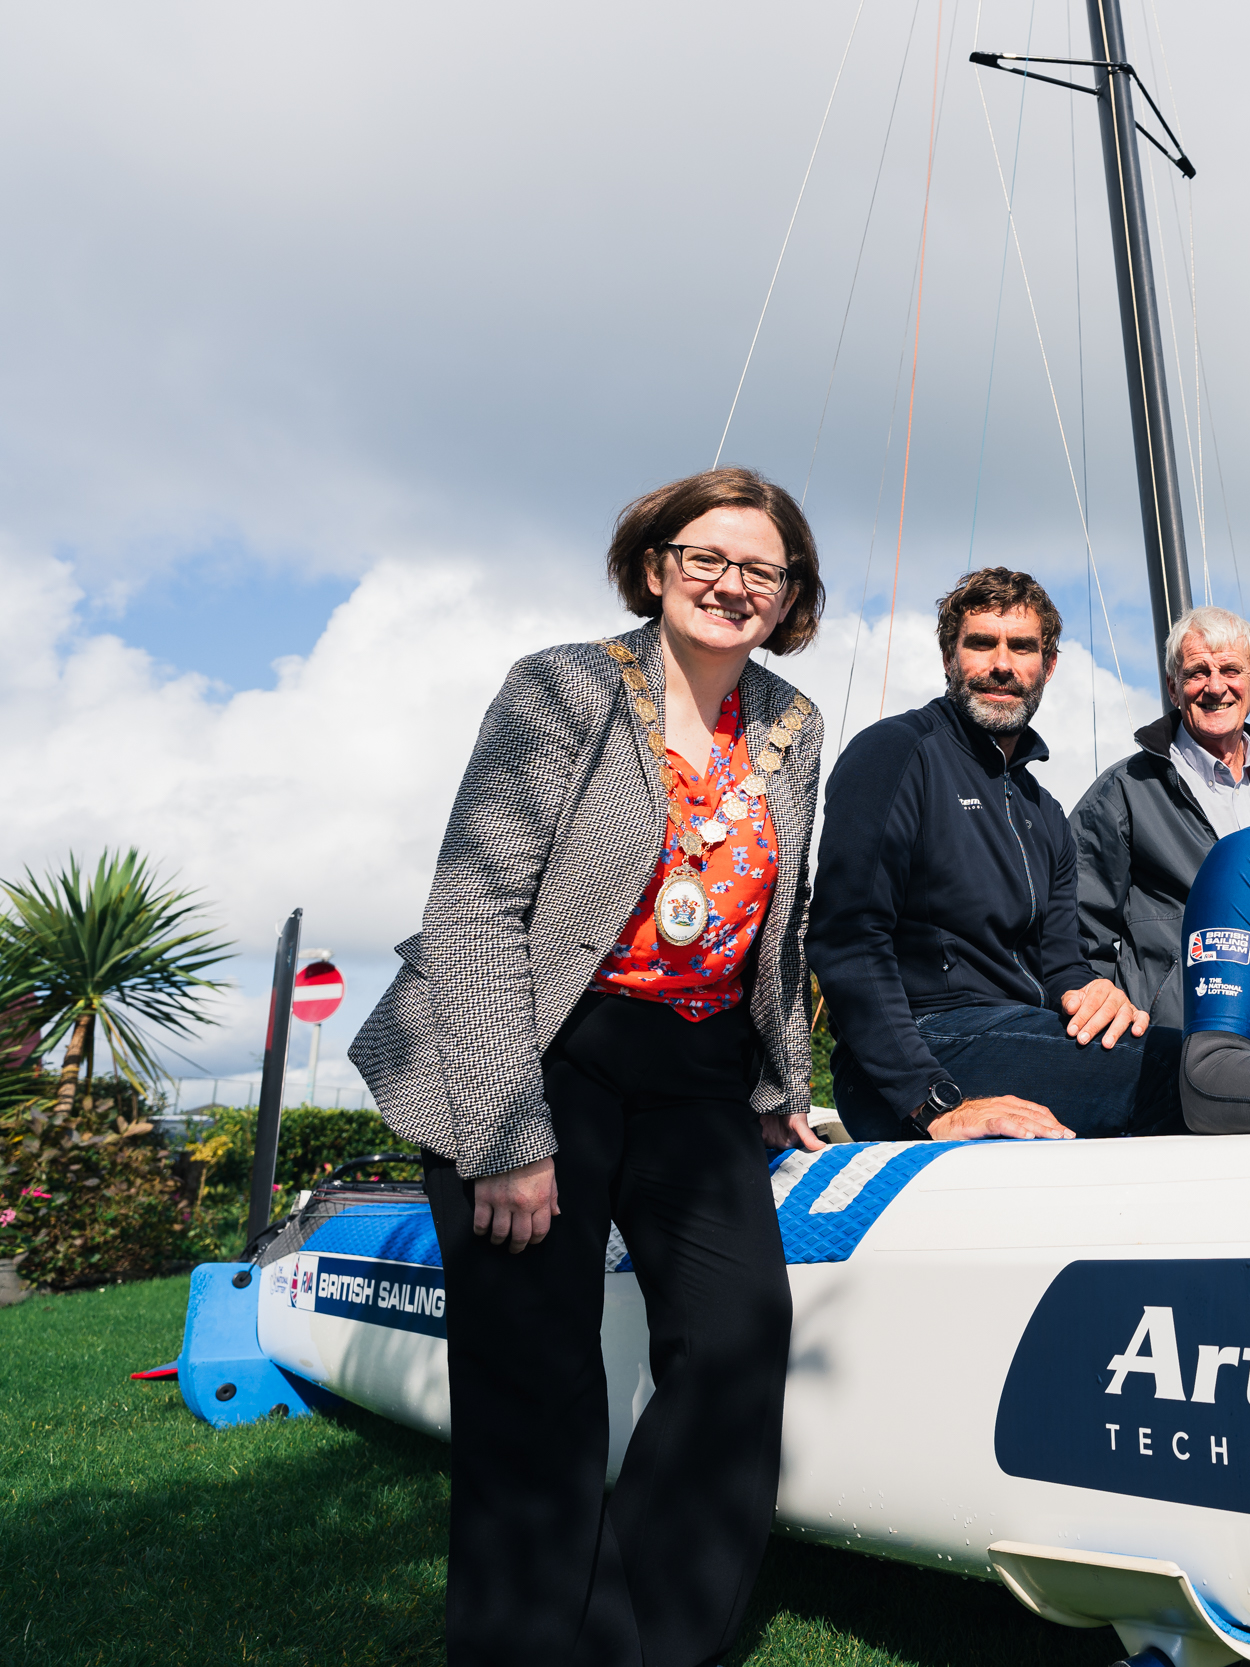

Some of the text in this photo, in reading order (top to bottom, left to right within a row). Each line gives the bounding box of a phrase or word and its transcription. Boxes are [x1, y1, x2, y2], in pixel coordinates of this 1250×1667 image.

[1206, 931, 1249, 941] BRITISH
[1205, 938, 1249, 948] SAILING
[1215, 944, 1248, 954] TEAM
[1207, 989, 1239, 997] LOTTERY
[1208, 983, 1243, 993] NATIONAL
[300, 1271, 314, 1295] RYA
[318, 1272, 446, 1318] BRITISH SAILING
